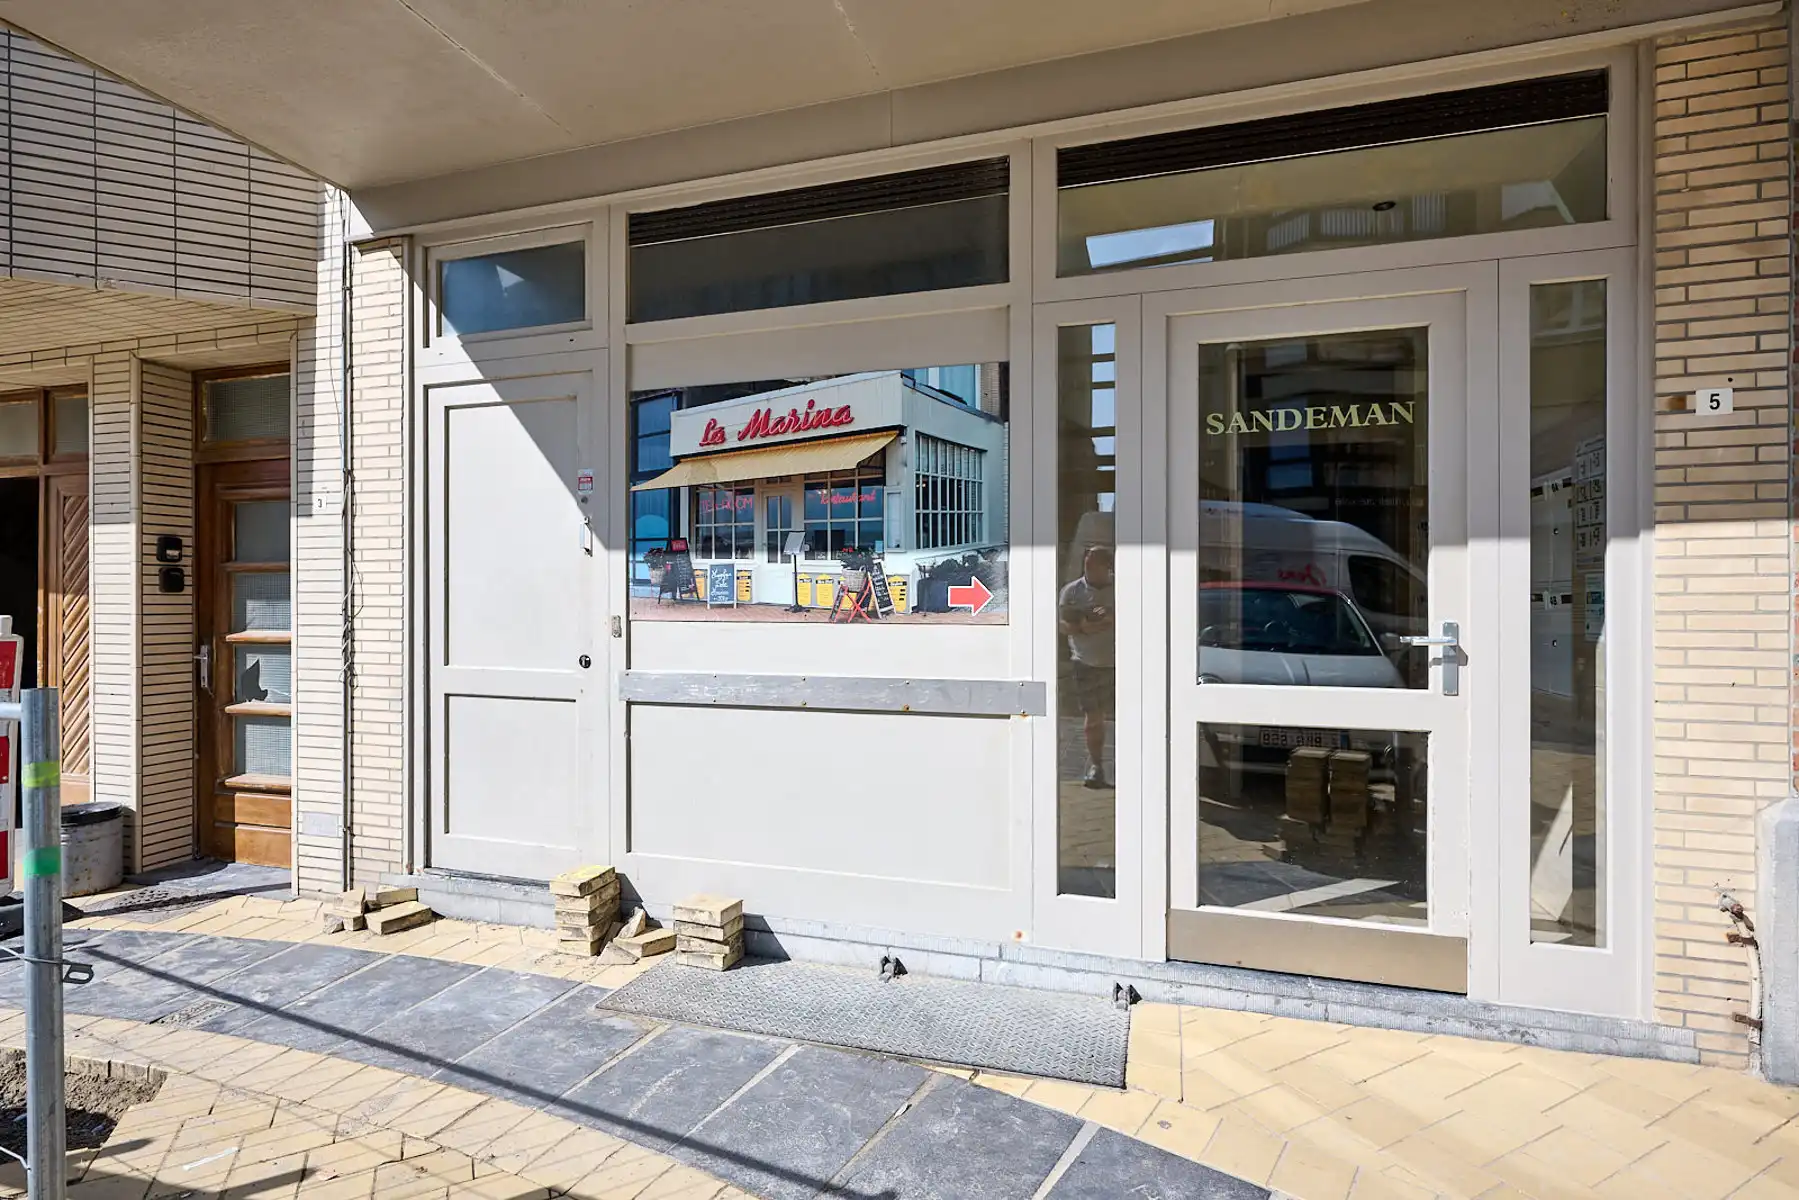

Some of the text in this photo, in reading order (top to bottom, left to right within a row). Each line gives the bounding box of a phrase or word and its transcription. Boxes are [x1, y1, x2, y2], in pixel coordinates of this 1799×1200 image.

[1206, 401, 1415, 435] SANDEMAN
[1709, 392, 1721, 410] 5
[699, 399, 855, 447] La Marina
